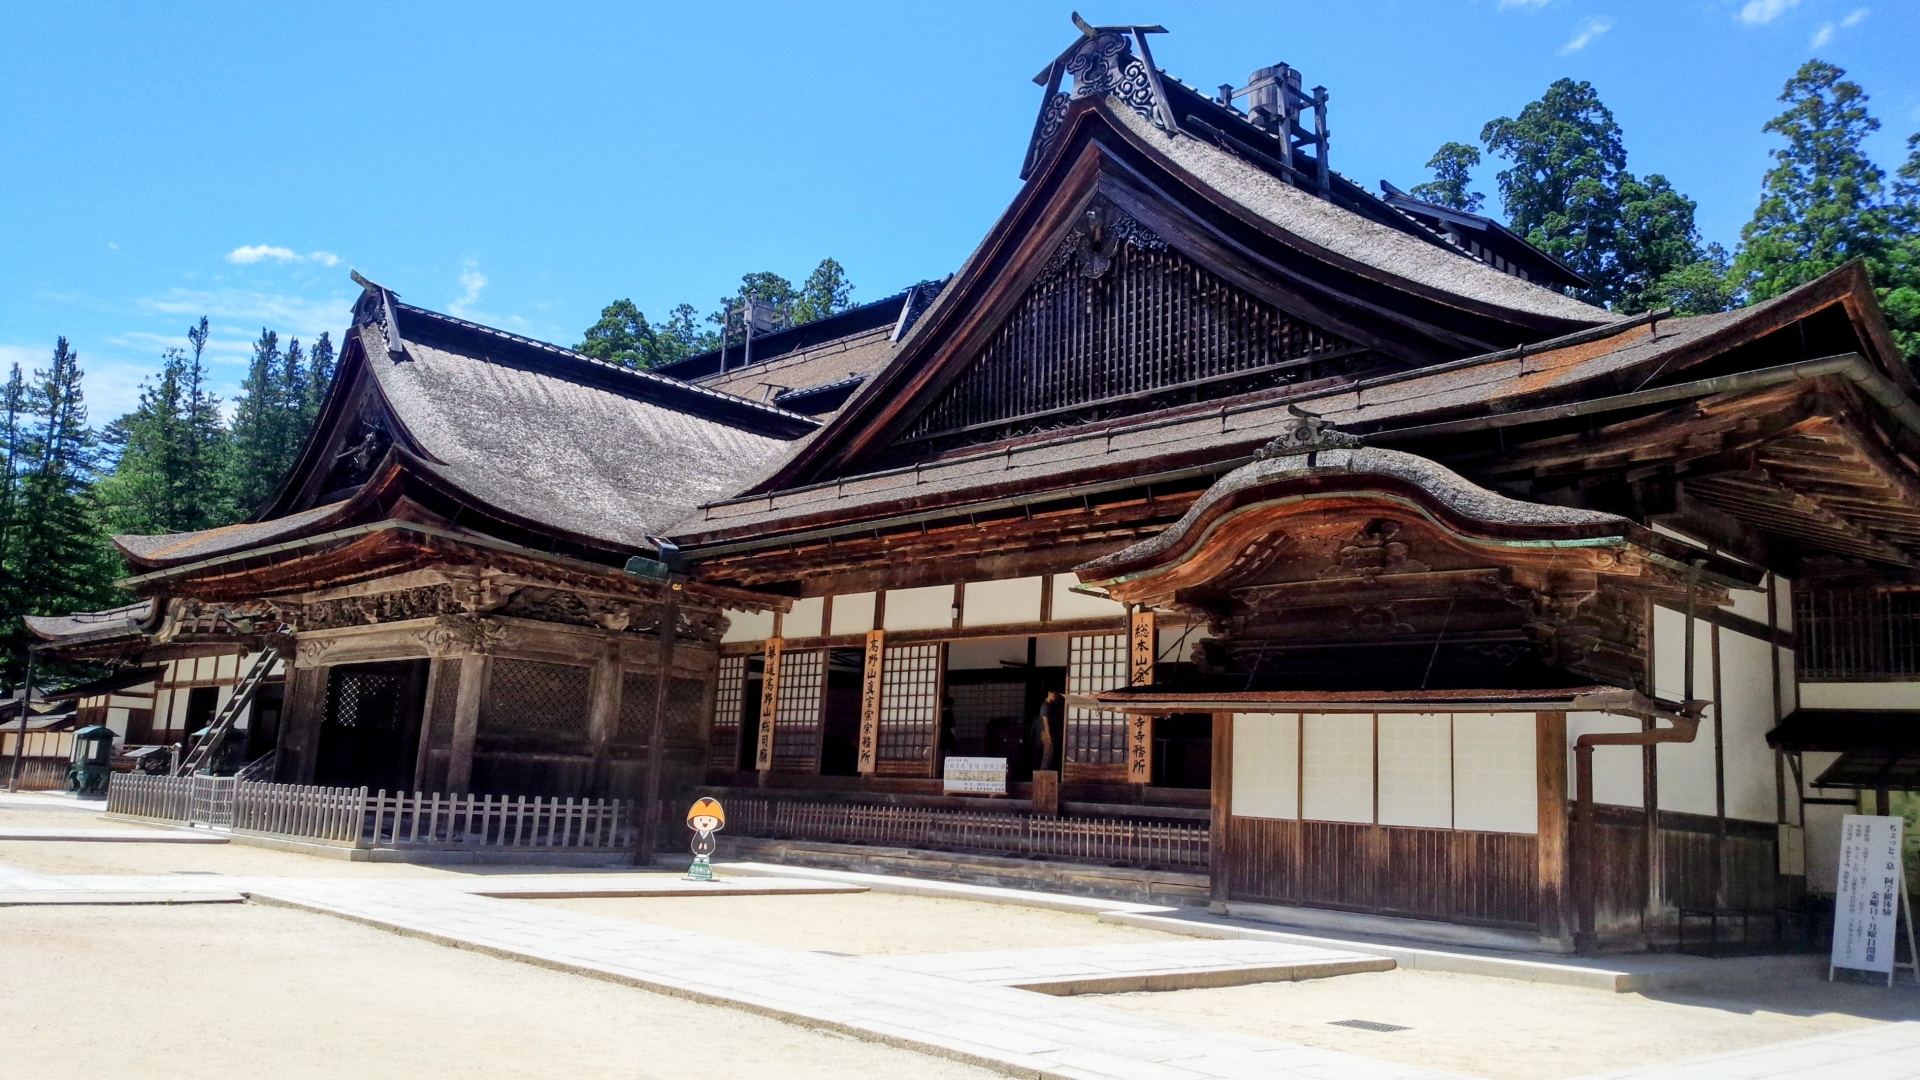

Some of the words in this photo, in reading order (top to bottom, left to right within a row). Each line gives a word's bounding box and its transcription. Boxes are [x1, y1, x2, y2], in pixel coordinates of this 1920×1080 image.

[860, 639, 879, 763] 高野山真言宗宗務所
